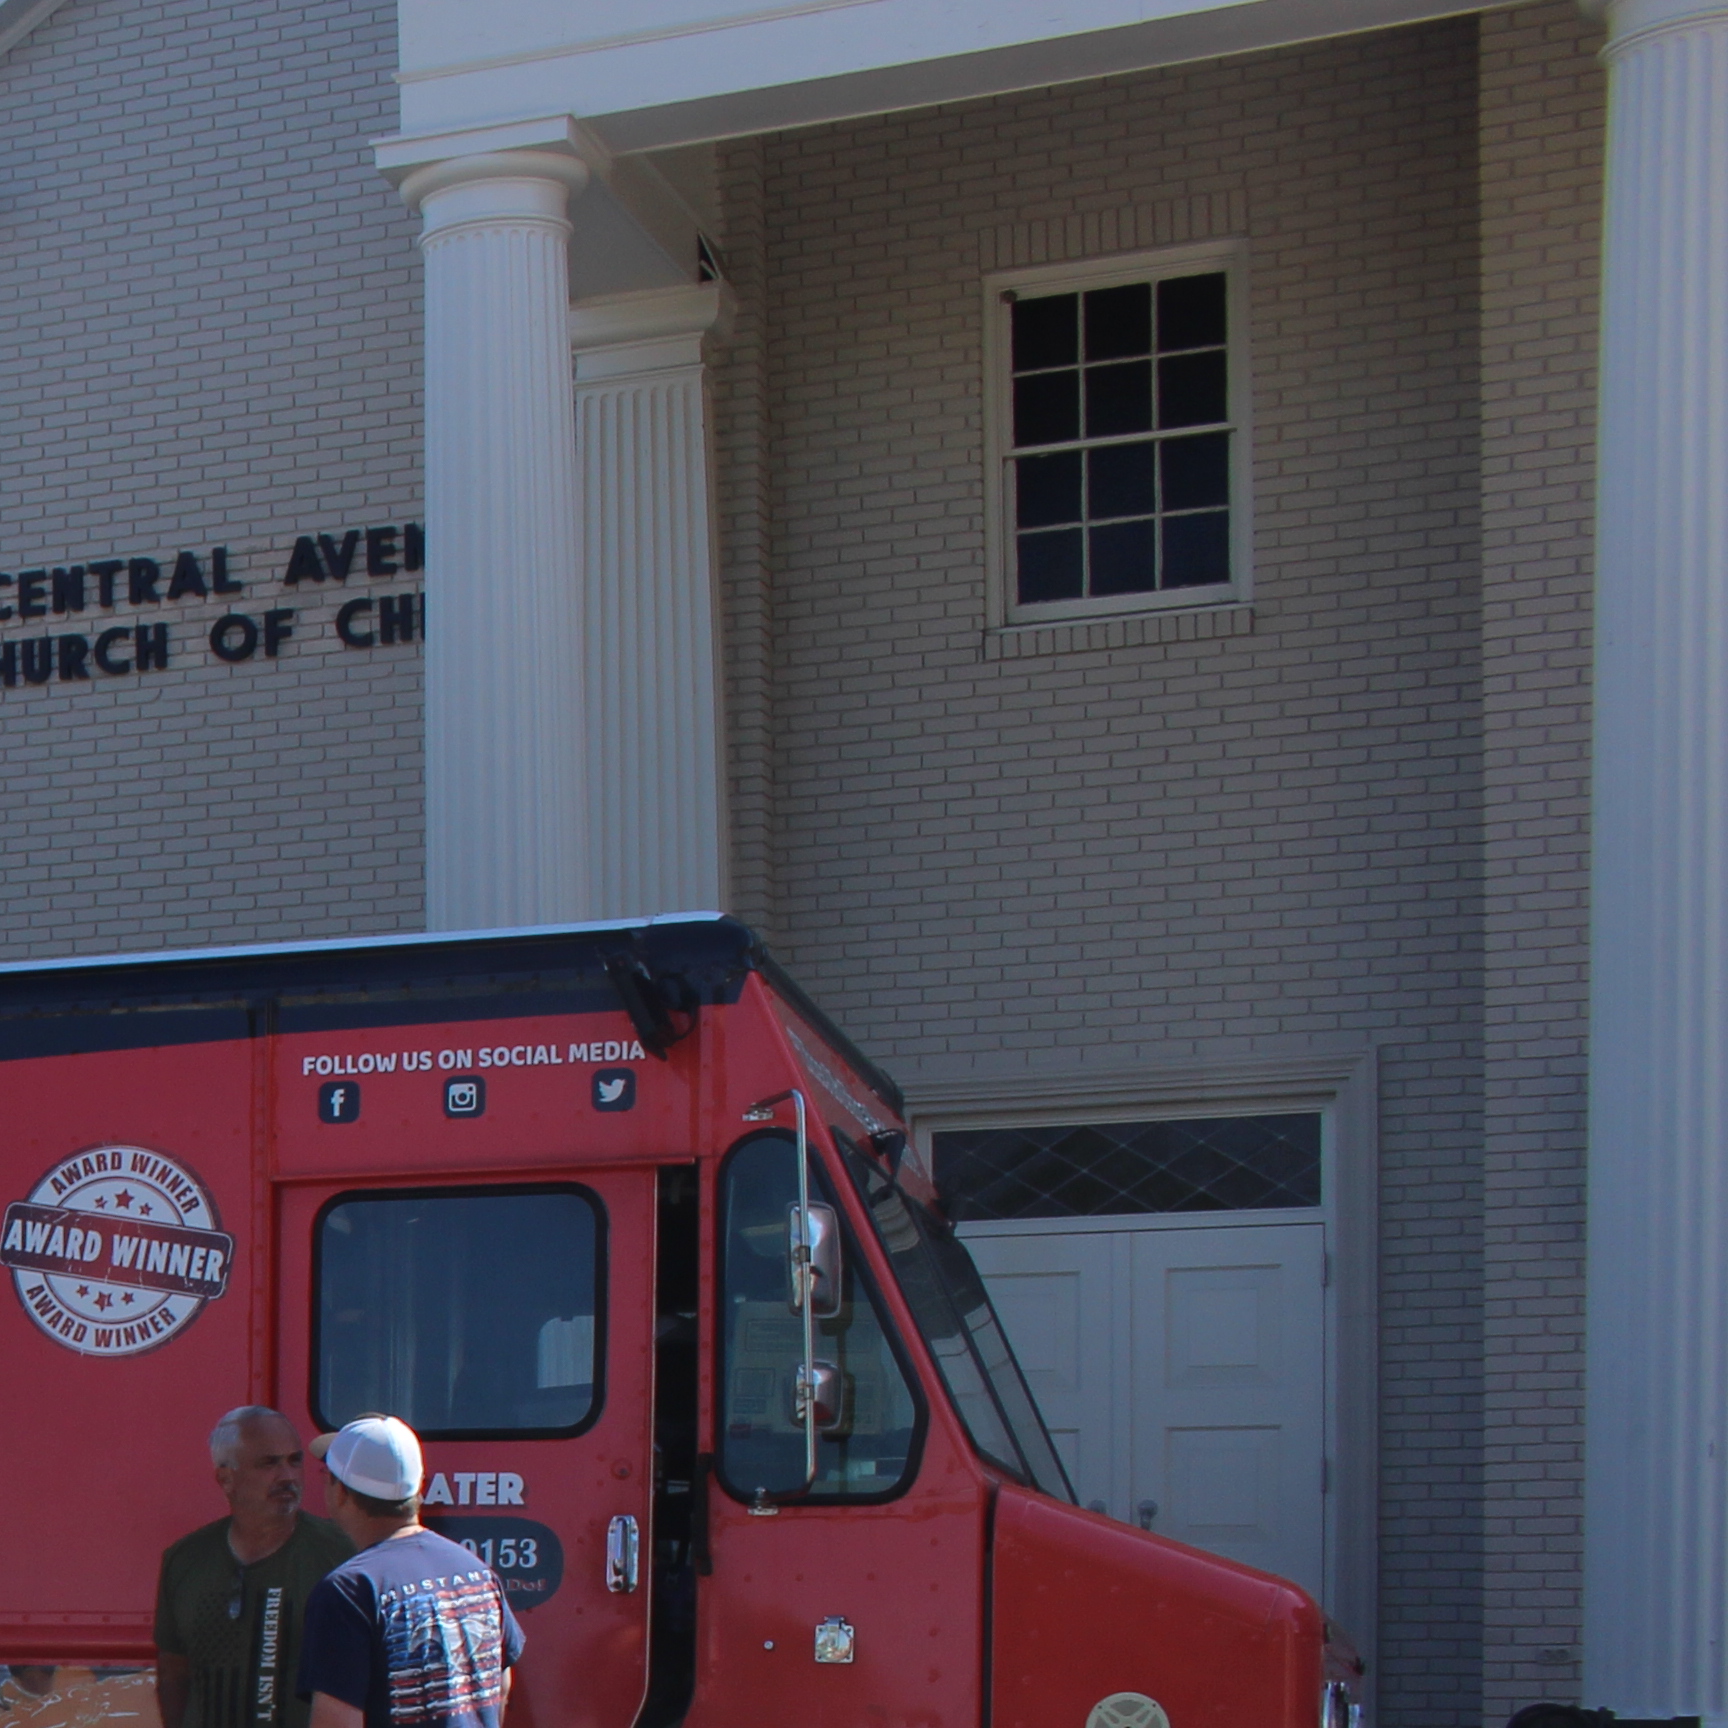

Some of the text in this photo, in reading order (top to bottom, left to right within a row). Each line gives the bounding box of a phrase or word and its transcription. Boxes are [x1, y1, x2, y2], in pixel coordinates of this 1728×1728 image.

[209, 607, 294, 663] OF
[335, 592, 426, 648] CH
[302, 1040, 646, 1076] FOLLOW US ON SOCIAL MEDIA
[49, 1151, 201, 1215] AWARD WINNER
[3, 1218, 225, 1283] AWARD WINNER
[26, 1284, 177, 1349] AWARD WINNER
[260, 1587, 283, 1668] FREEDOM
[256, 1675, 277, 1722] ISN'T
